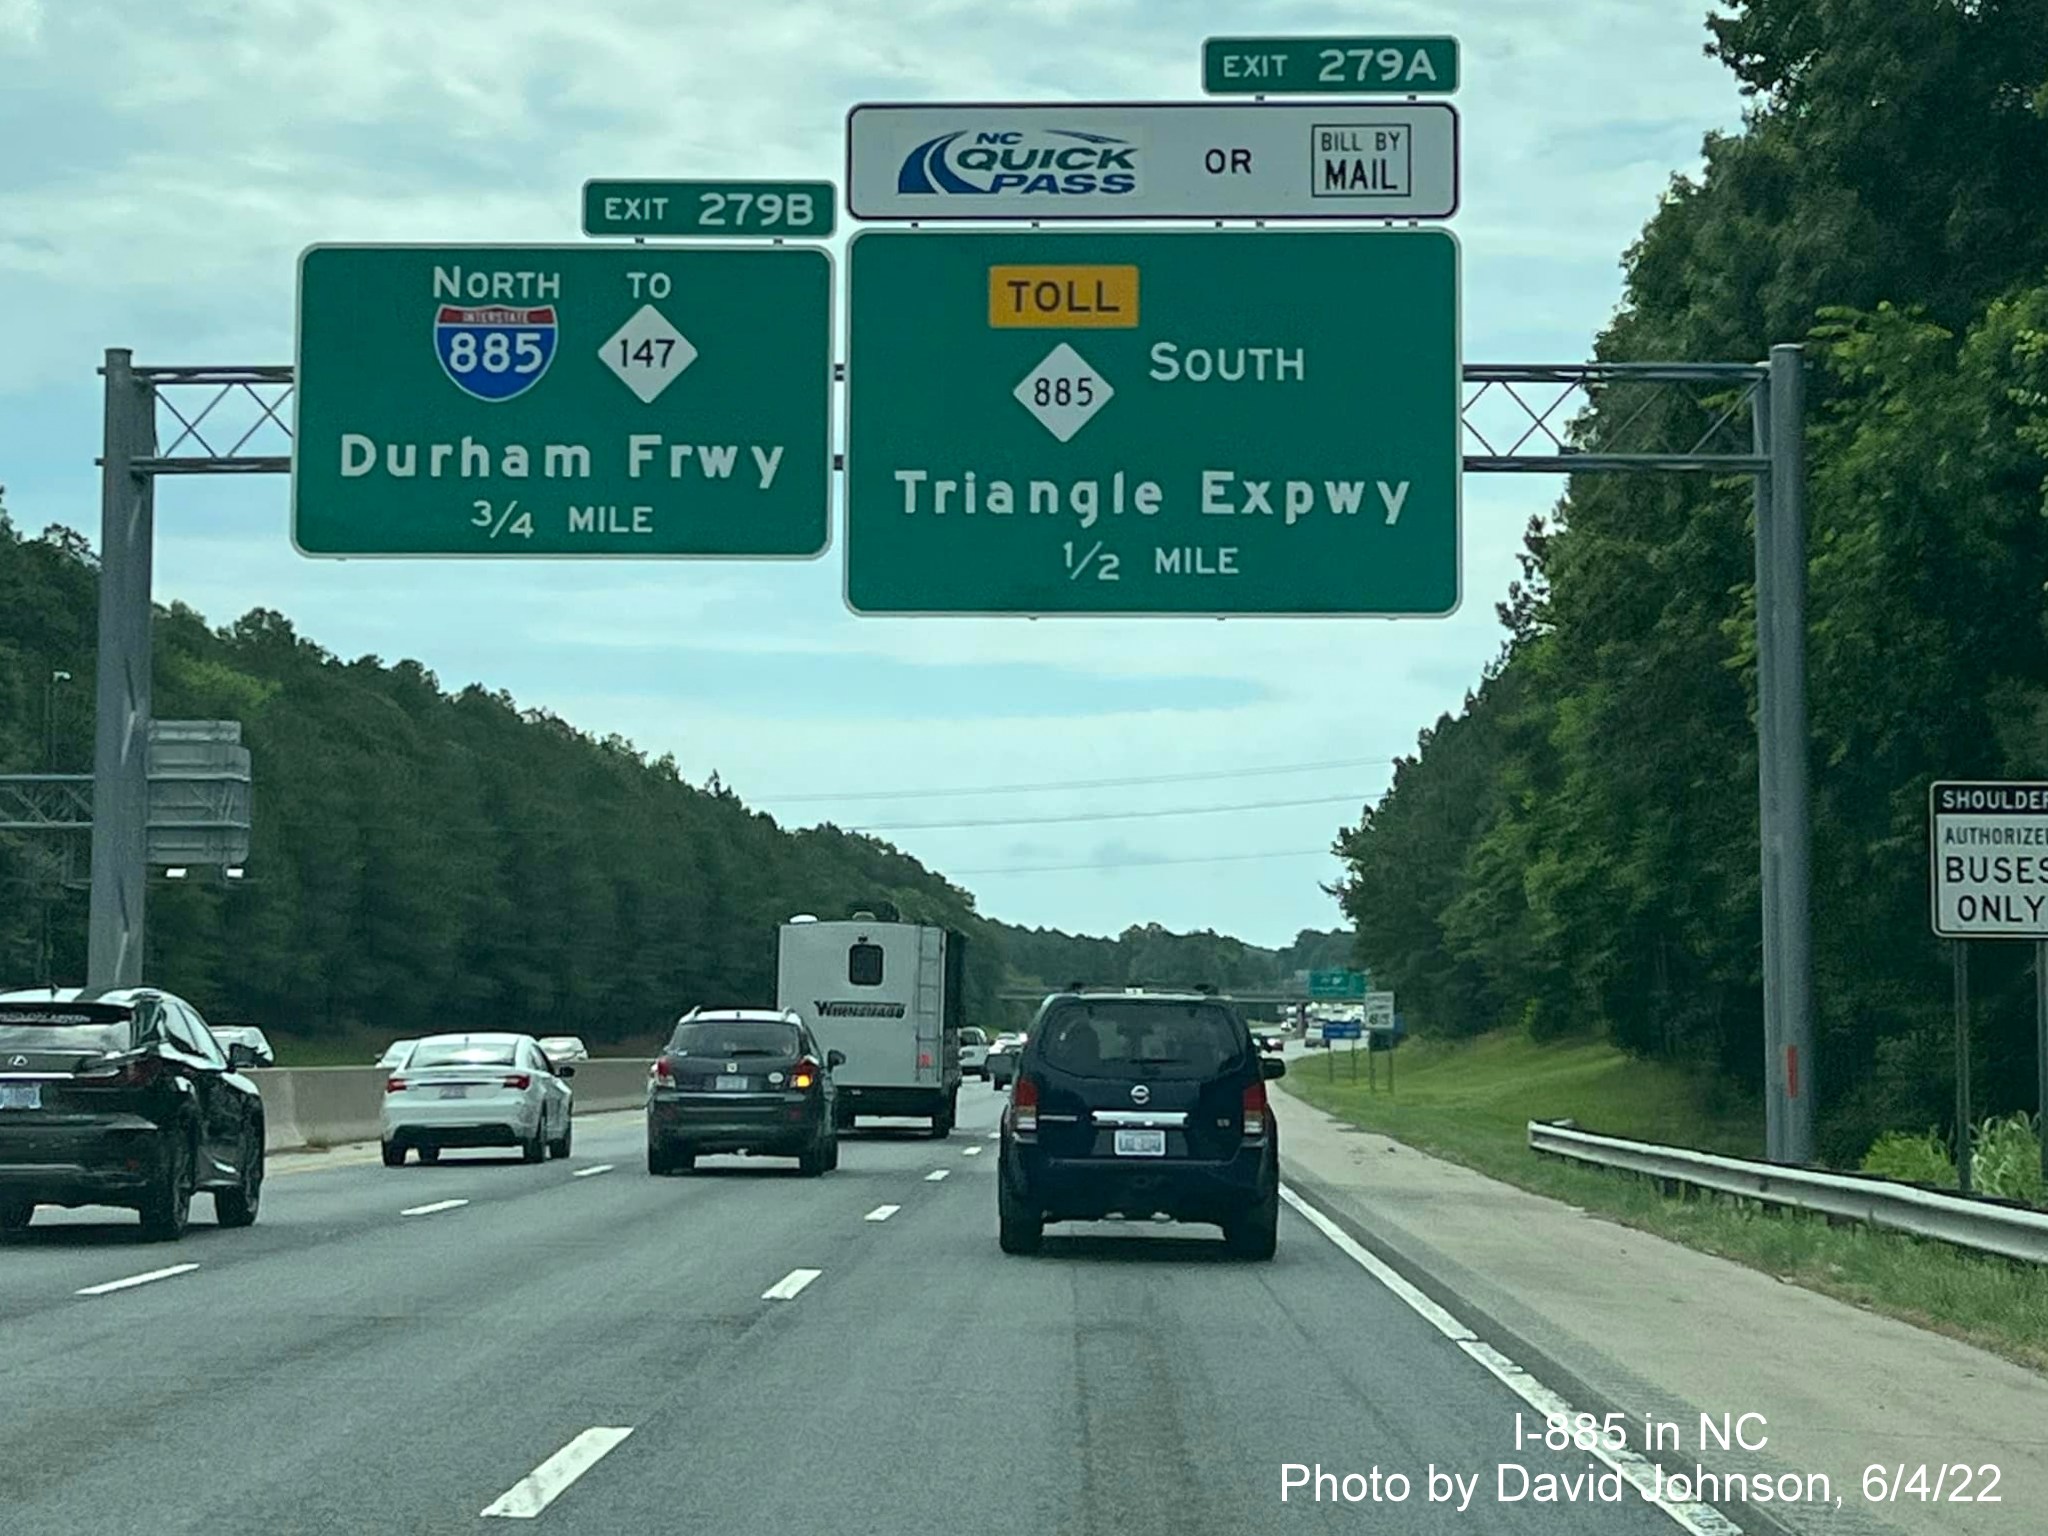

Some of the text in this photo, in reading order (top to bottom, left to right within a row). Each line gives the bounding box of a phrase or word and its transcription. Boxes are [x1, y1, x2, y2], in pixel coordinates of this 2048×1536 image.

[1223, 48, 1437, 82] EXIT 279A
[976, 132, 1023, 144] NC
[1320, 131, 1401, 152] BILL BY
[956, 147, 1138, 170] QUICK
[1205, 148, 1252, 175] OR
[1325, 158, 1398, 190] MAIL
[988, 174, 1136, 194] PASS
[604, 192, 814, 226] EXIT 279B
[433, 265, 560, 299] NORTH
[626, 272, 671, 299] TO
[1006, 279, 1120, 313] TOLL
[448, 332, 544, 375] 885
[620, 338, 676, 368] 147
[1149, 341, 1304, 382] SOUTH
[1034, 377, 1093, 407] 885
[340, 433, 784, 489] Durham Frwy
[894, 470, 1410, 529] Triangle Expwy
[470, 500, 653, 539] 3/4 MILE
[1063, 540, 1239, 581] 1/2 MILE
[1958, 895, 2046, 922] ONLY
